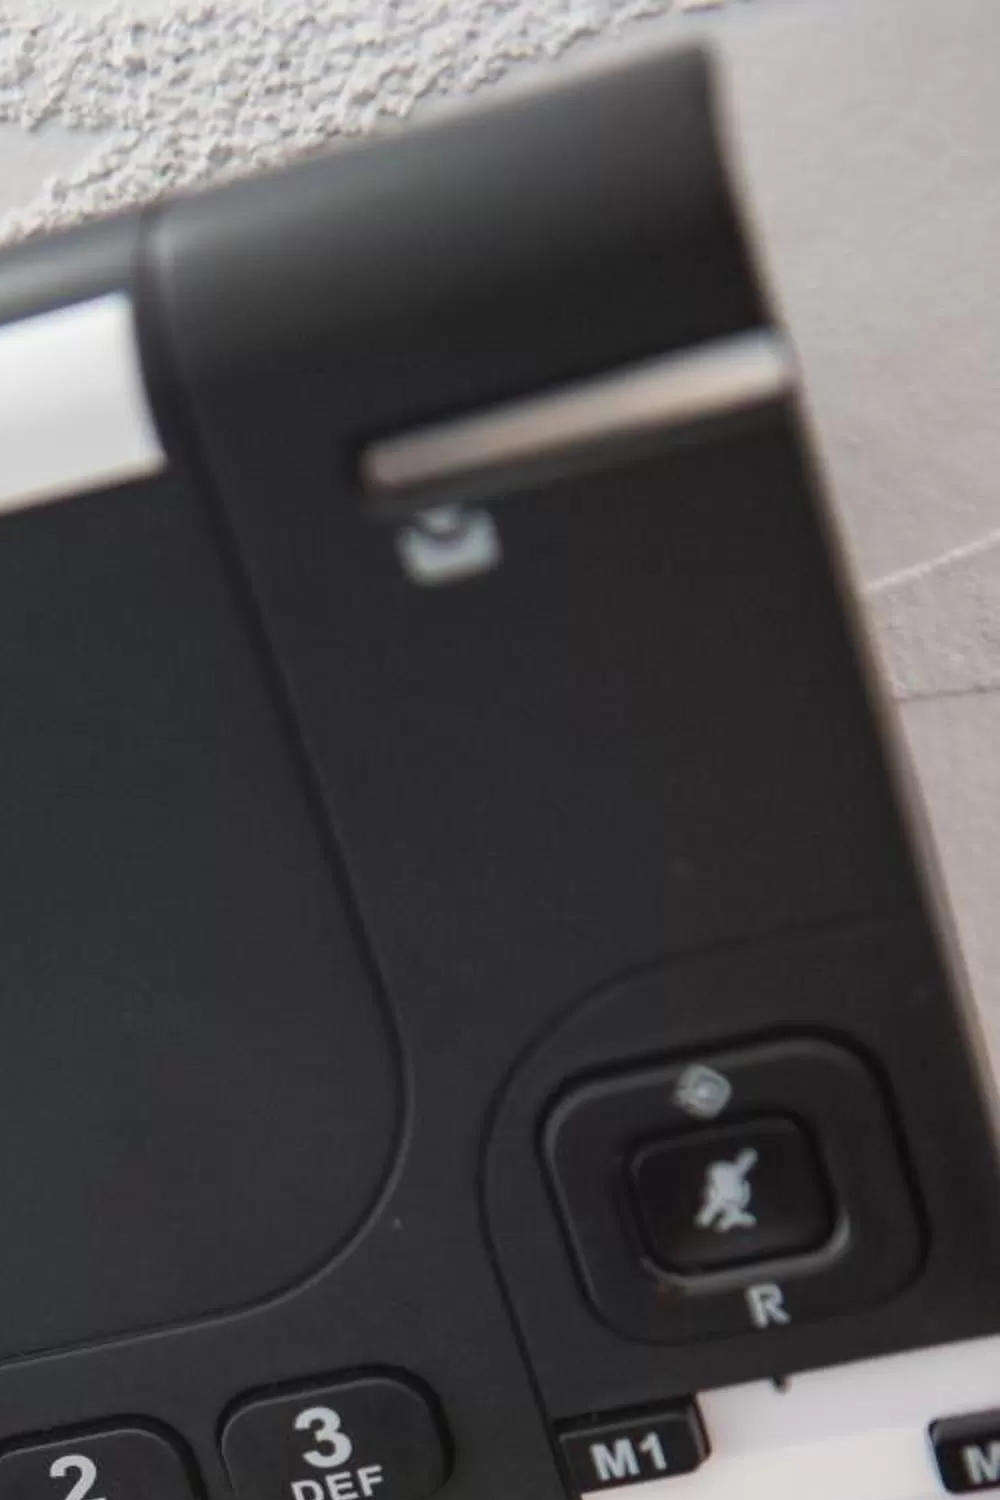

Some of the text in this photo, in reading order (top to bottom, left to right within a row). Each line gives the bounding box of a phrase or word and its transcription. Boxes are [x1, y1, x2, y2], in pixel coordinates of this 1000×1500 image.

[747, 1283, 789, 1328] R
[294, 1406, 353, 1469] 3
[591, 1432, 668, 1481] M1
